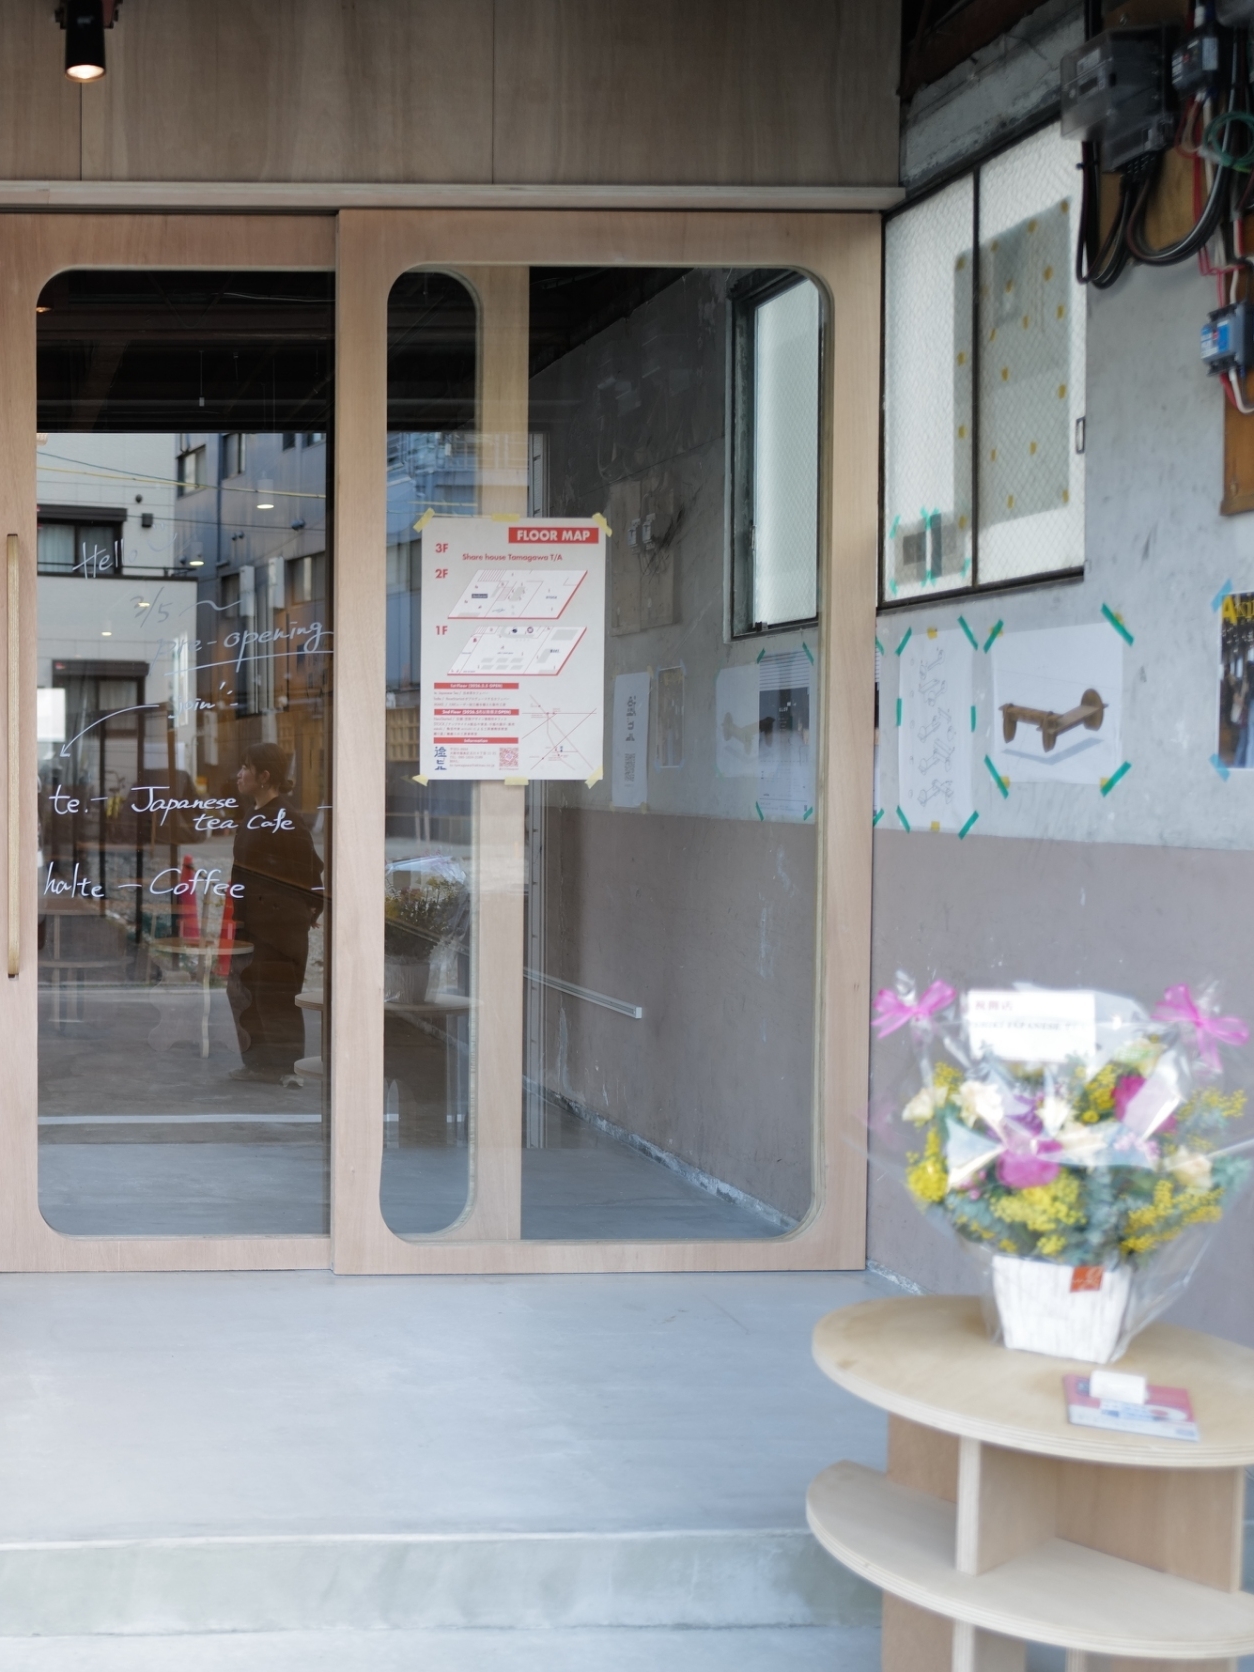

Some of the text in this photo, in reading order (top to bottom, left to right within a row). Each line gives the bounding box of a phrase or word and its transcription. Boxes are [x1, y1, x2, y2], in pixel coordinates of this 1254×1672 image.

[516, 530, 590, 541] FLOOR MAP
[435, 543, 449, 553] 3F
[72, 538, 138, 579] Hello
[462, 553, 484, 561] Share
[484, 553, 506, 561] house
[508, 554, 549, 562] Tamagawa
[435, 569, 449, 579] 2F
[435, 625, 448, 635] 1F
[131, 786, 239, 826] Japanese
[192, 814, 239, 831] tea
[43, 861, 105, 898] halte
[149, 868, 246, 899] Coffee
